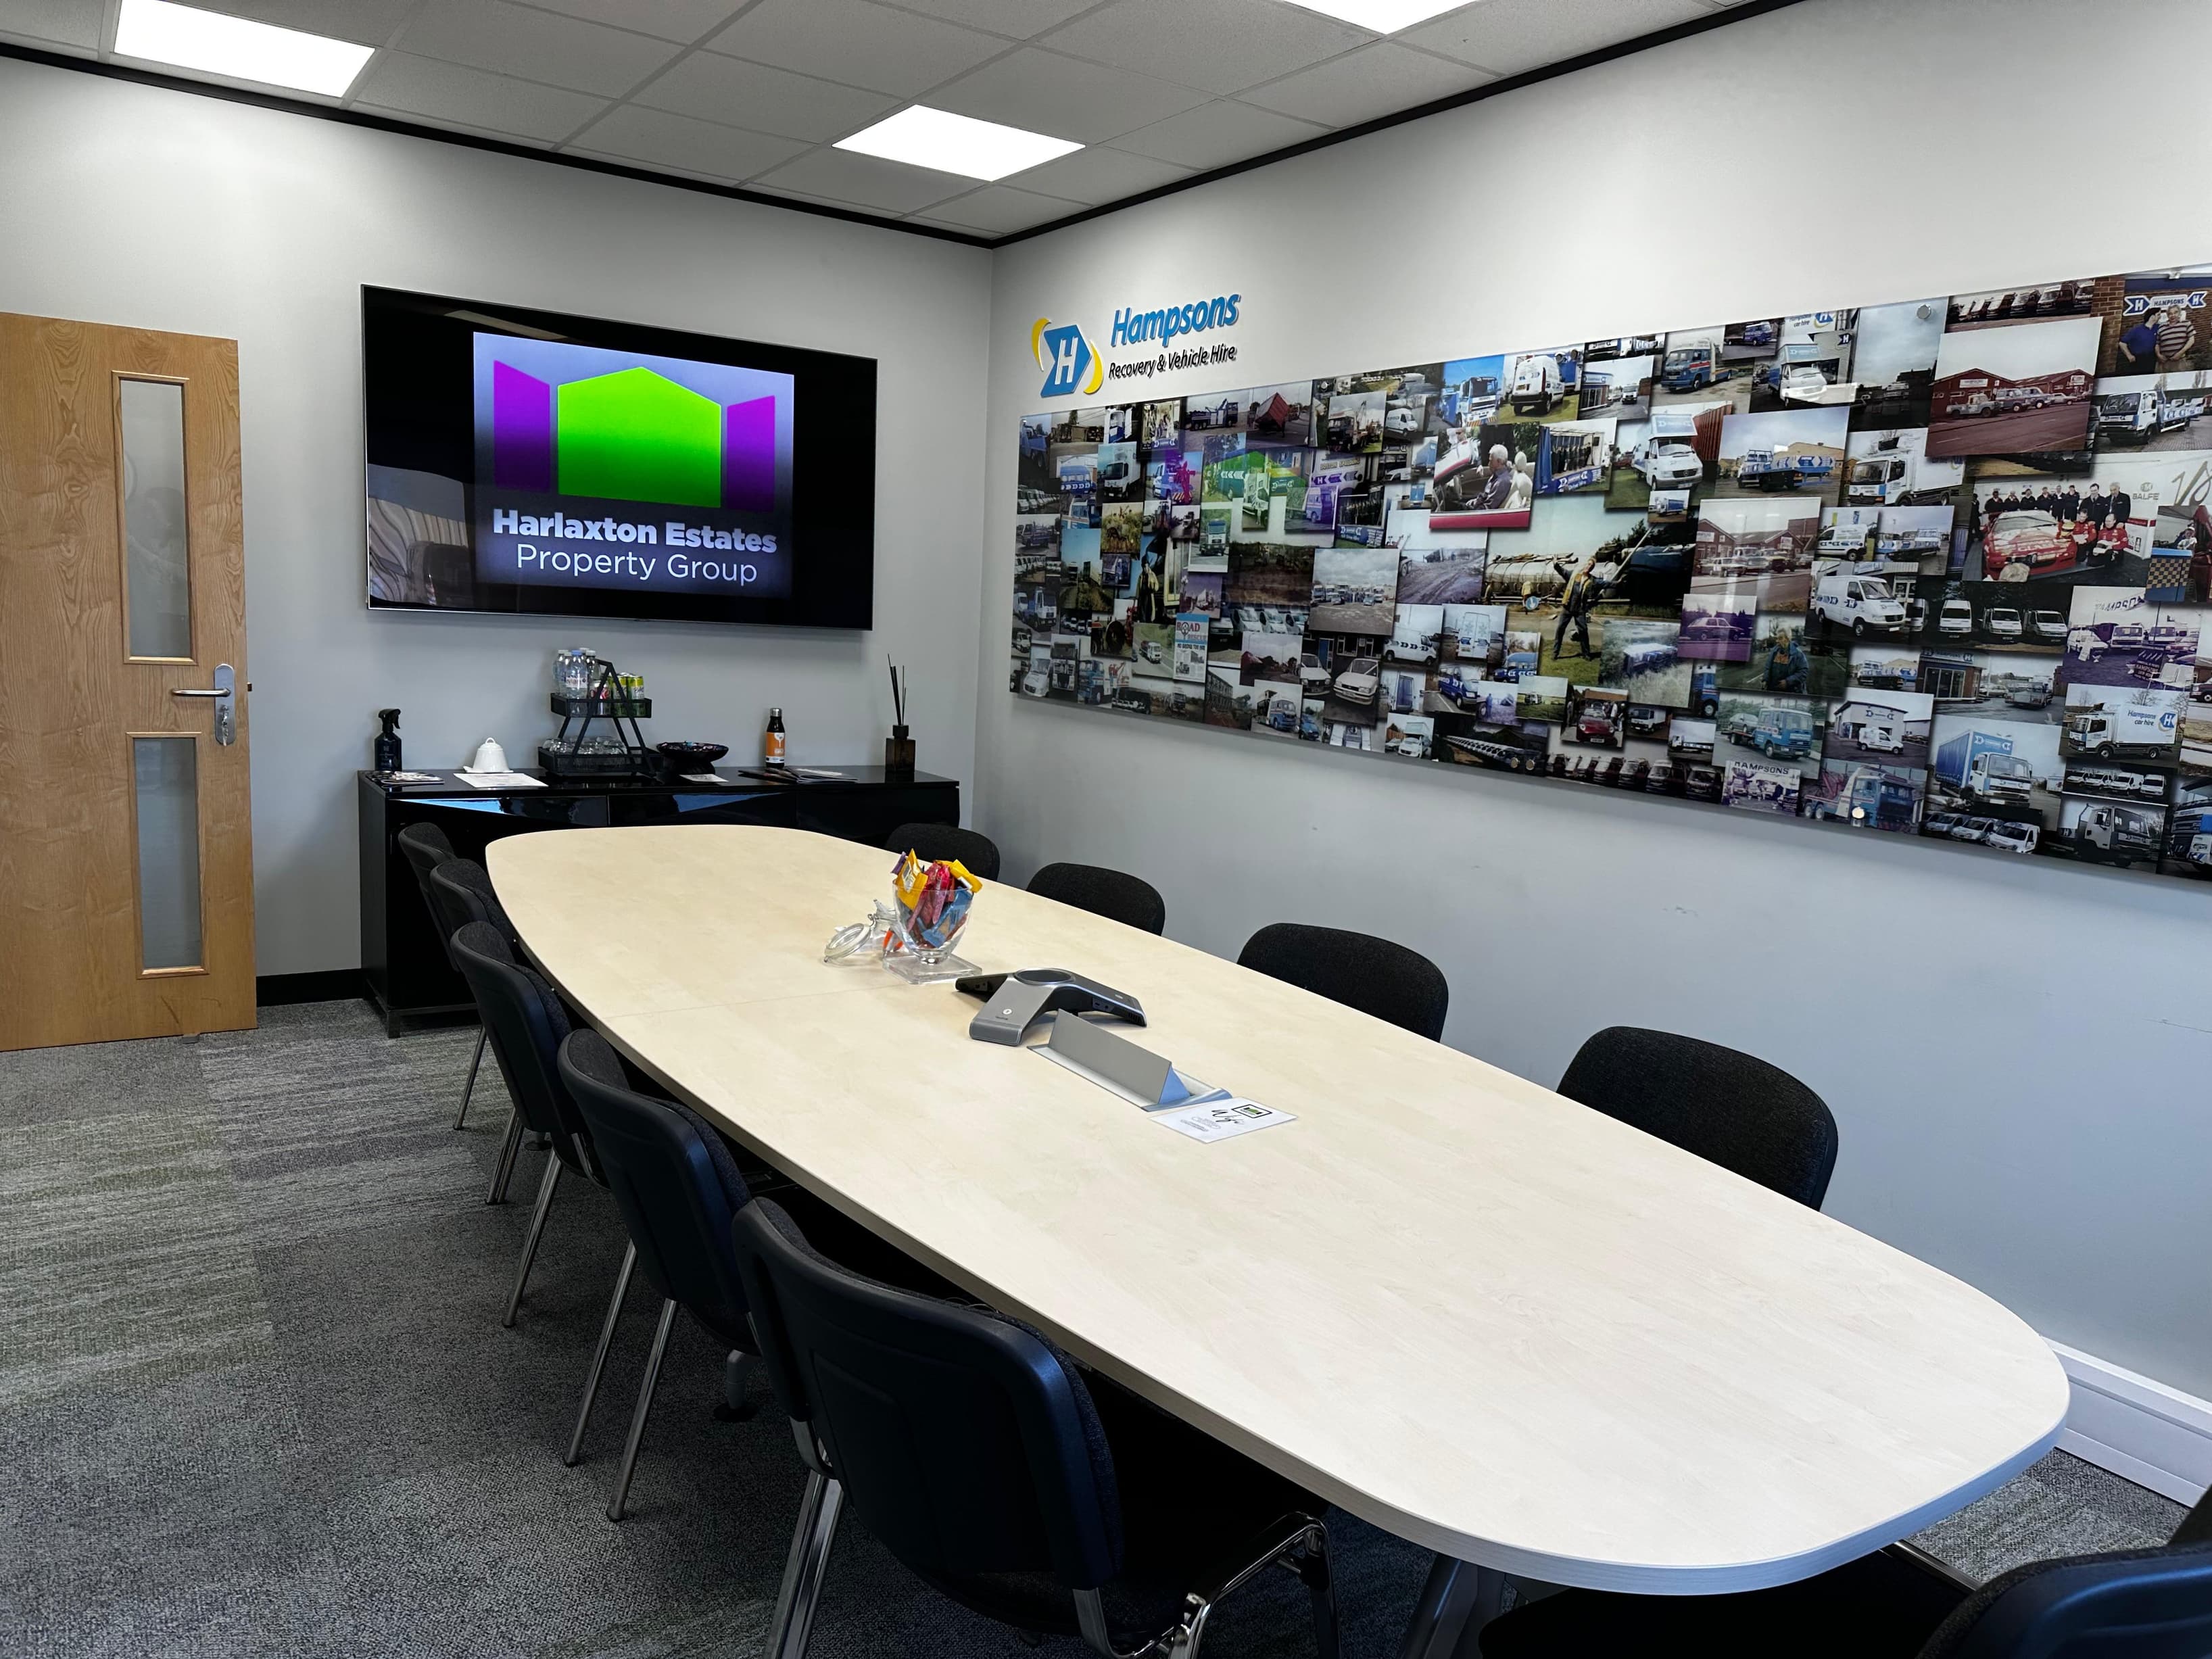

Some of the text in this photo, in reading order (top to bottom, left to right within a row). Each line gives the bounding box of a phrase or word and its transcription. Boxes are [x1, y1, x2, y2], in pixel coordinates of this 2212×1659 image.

[1111, 293, 1241, 347] Hampsons
[2153, 297, 2185, 307] HAMPSONS
[1055, 337, 1078, 385] H
[1109, 343, 1237, 379] Recovery & Vehicle Hire
[2132, 493, 2160, 501] BALFE
[493, 508, 778, 553] Harlaxton Estates
[517, 543, 758, 586] Property Group
[1176, 622, 1201, 634] ROAD
